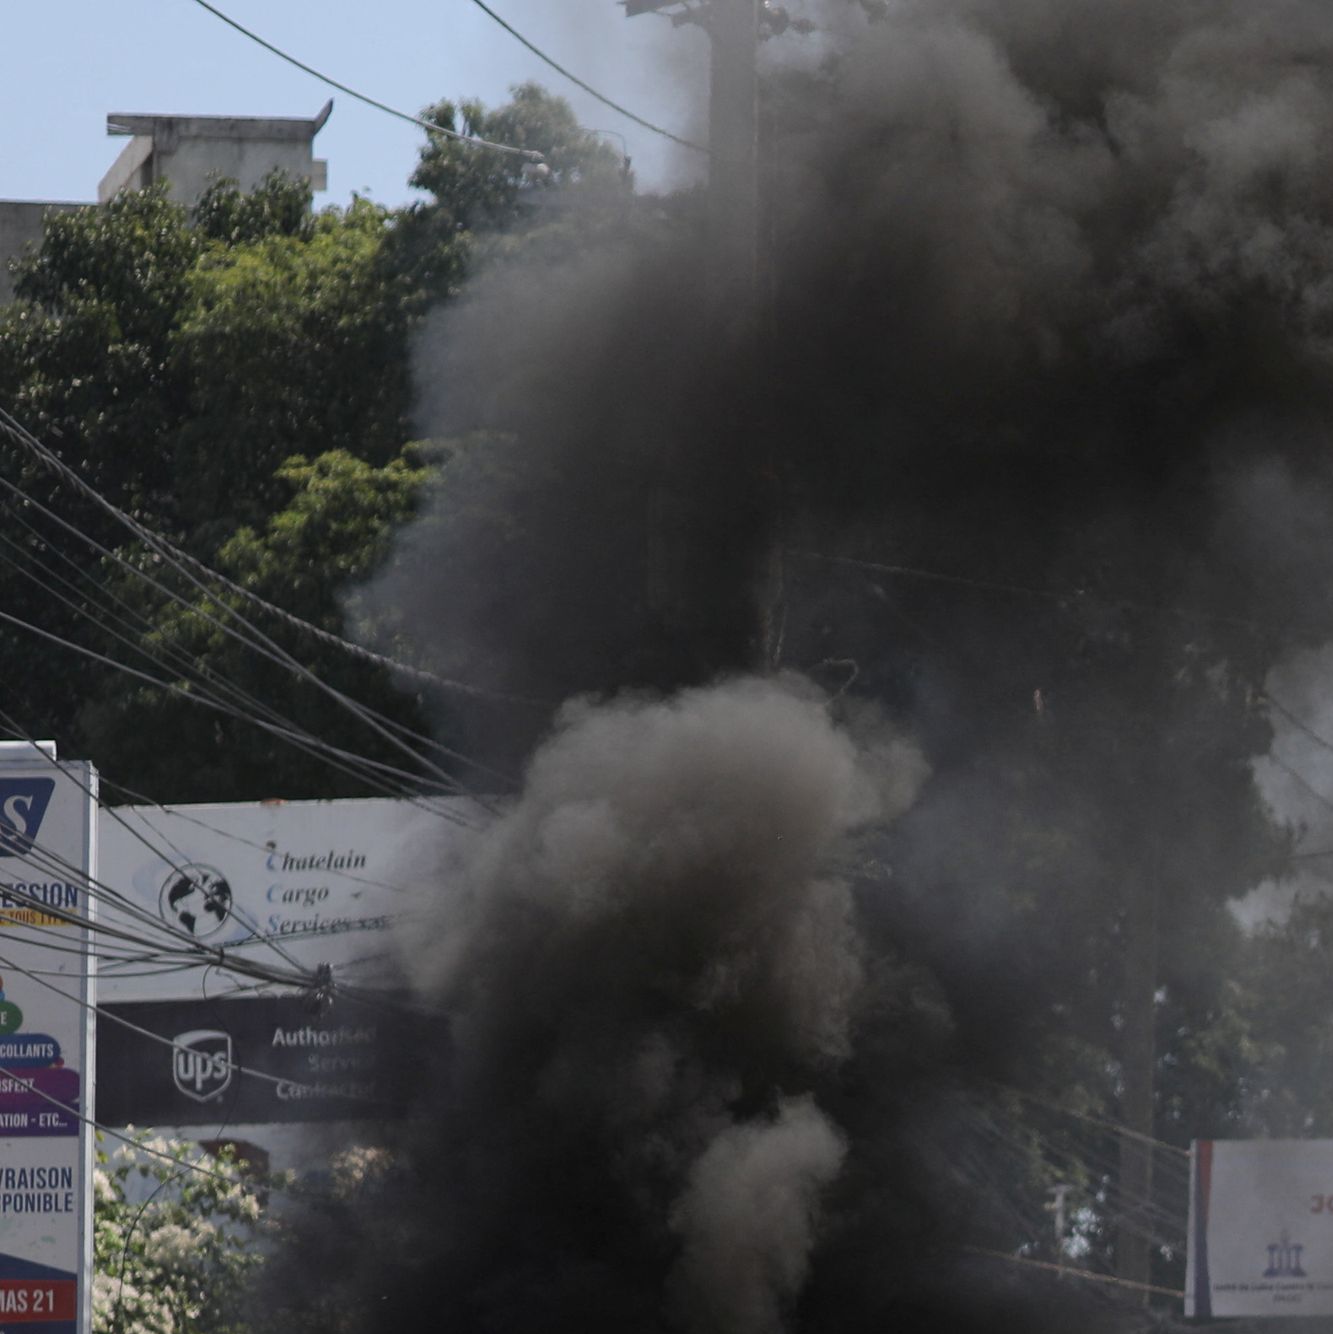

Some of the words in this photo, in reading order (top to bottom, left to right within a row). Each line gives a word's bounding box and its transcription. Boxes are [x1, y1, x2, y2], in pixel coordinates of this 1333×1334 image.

[265, 883, 330, 907] Cargo
[177, 1052, 226, 1091] ups
[0, 1078, 35, 1094] SFERT
[0, 1191, 73, 1213] PONIBLE
[32, 1289, 55, 1313] 21
